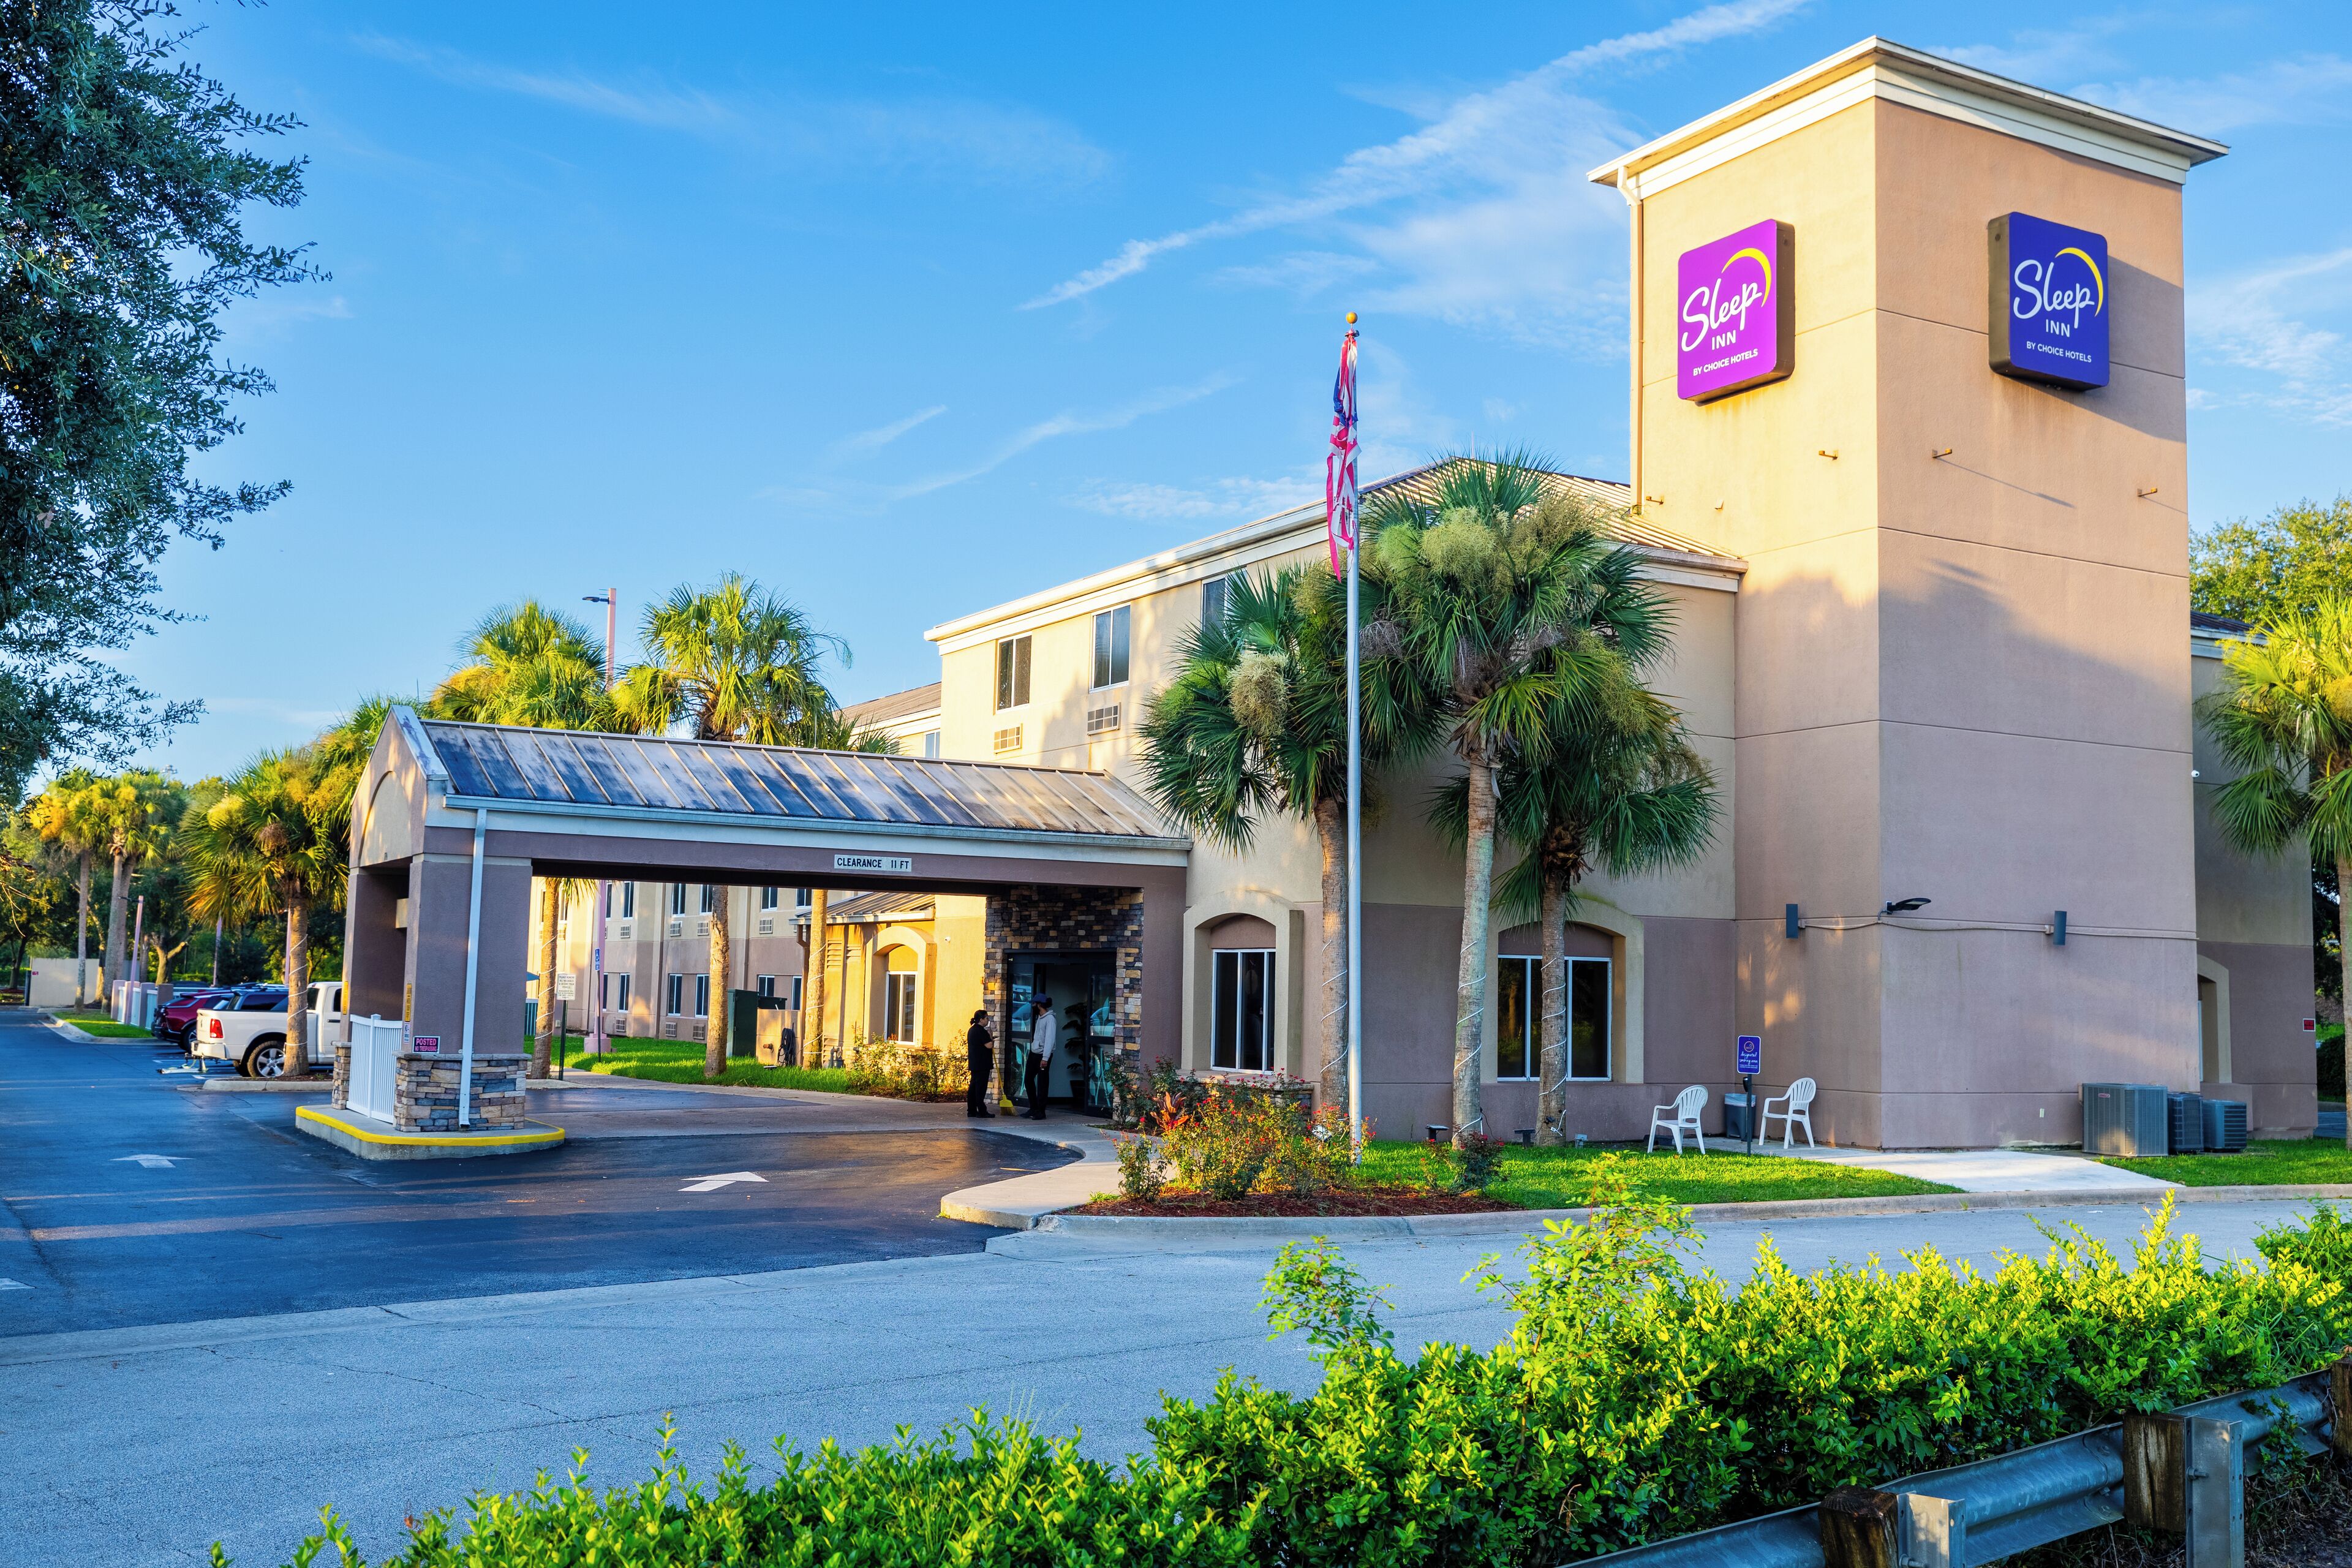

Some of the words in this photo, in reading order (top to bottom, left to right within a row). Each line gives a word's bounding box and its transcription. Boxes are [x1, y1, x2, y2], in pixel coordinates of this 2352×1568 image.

[2013, 259, 2095, 329] Sleep
[1681, 278, 1762, 352] Sleep
[2046, 318, 2070, 337] INN
[1711, 330, 1736, 350] INN
[1693, 368, 1703, 376] BY
[1703, 357, 1730, 373] CHOICE
[1730, 348, 1758, 364] HOTELS
[2026, 341, 2036, 350] BY
[2037, 343, 2064, 357] CHOICE
[2065, 349, 2092, 363] HOTELS
[837, 858, 882, 868] CLEARANCE
[891, 859, 897, 869] 11
[900, 861, 909, 869] FT
